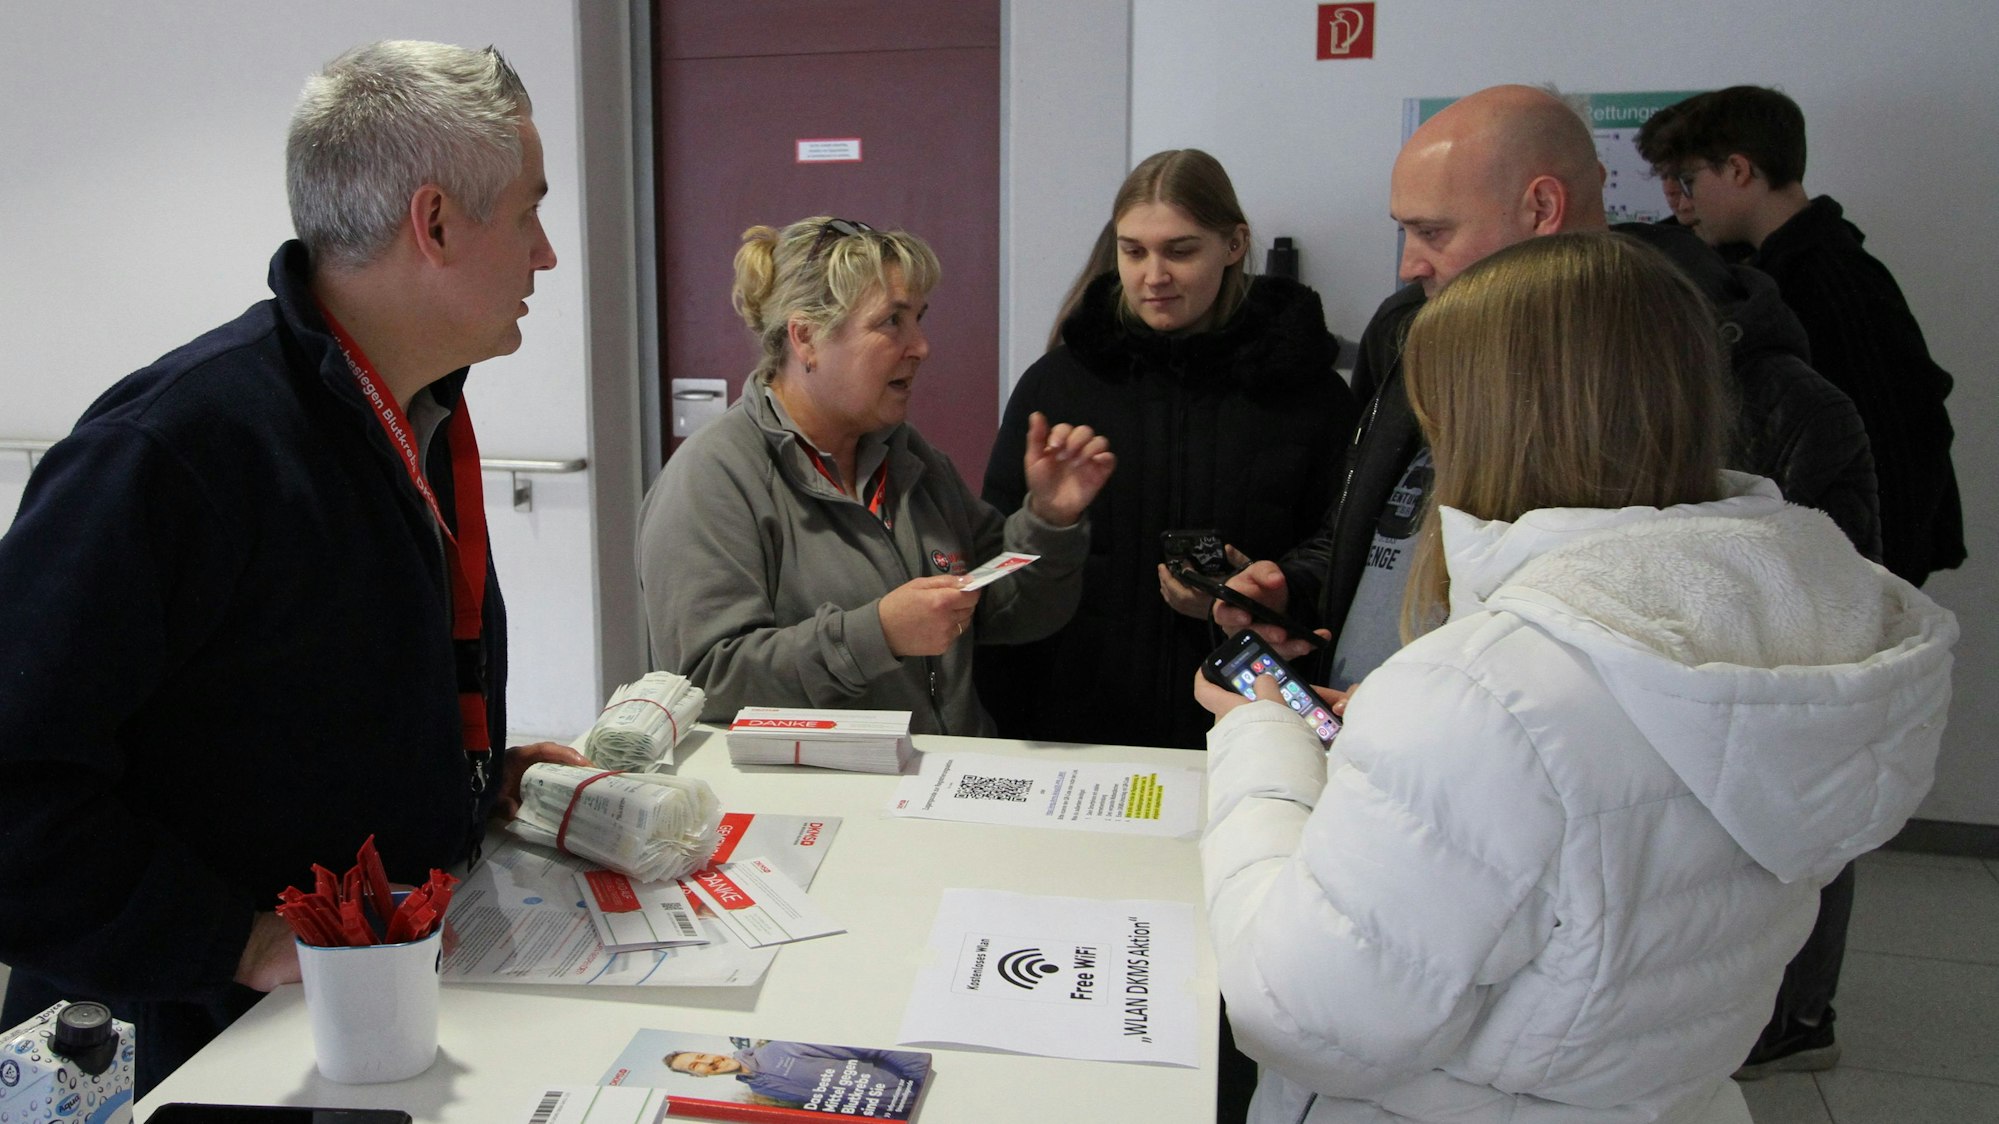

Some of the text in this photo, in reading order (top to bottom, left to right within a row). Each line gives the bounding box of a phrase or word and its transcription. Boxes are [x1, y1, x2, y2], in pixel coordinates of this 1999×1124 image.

[748, 720, 819, 729] DANKE
[699, 871, 743, 903] DANKE
[967, 952, 987, 991] Kostenloses
[1070, 946, 1097, 1001] Free WiFi
[1126, 959, 1150, 995] DKMS
[36, 1003, 63, 1021] Joyce
[803, 1068, 836, 1111] Das beste
[822, 1059, 859, 1113] Mittel gegen
[841, 1073, 871, 1115] Blutkrebs
[861, 1083, 886, 1117] sind Sie
